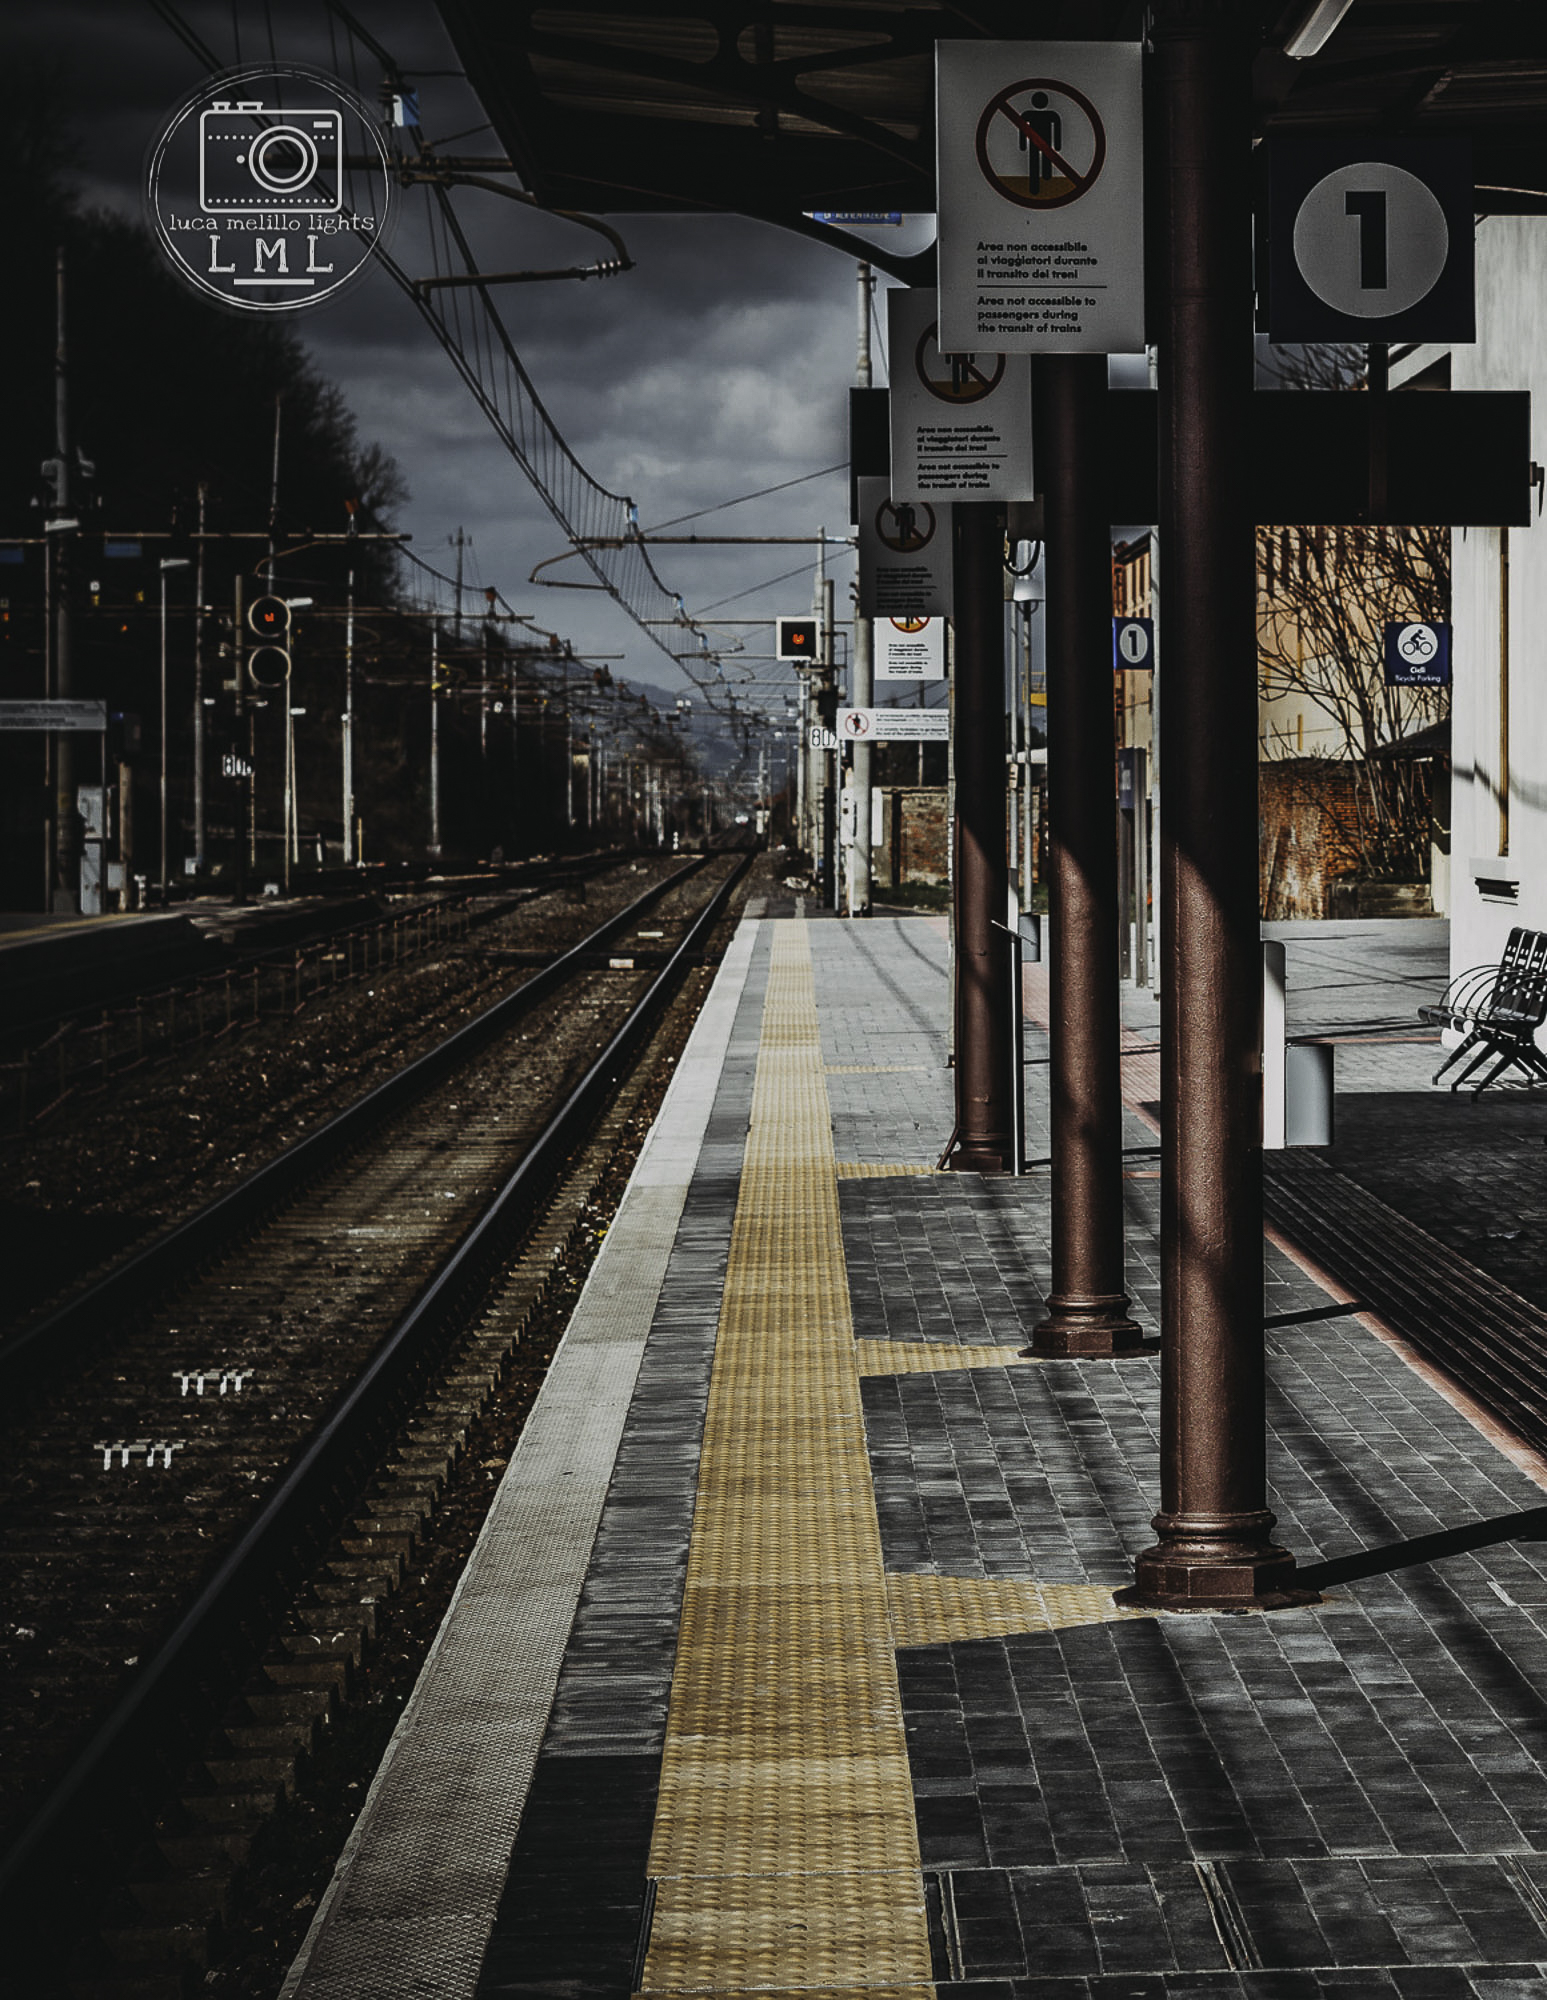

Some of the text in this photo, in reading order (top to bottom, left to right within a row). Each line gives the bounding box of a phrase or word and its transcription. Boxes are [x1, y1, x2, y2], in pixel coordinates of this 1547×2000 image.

[1345, 191, 1387, 289] 1
[977, 242, 1003, 251] Area
[1031, 242, 1088, 251] accessibile
[977, 255, 1098, 267] ai viaggiatori durante
[988, 269, 1029, 279] transito
[1032, 269, 1049, 278] dei
[1052, 269, 1078, 278] treni
[977, 296, 1096, 305] Area not accessible to
[978, 310, 1078, 320] passengers during
[978, 323, 1082, 333] the transit of trains
[1128, 630, 1138, 657] 1
